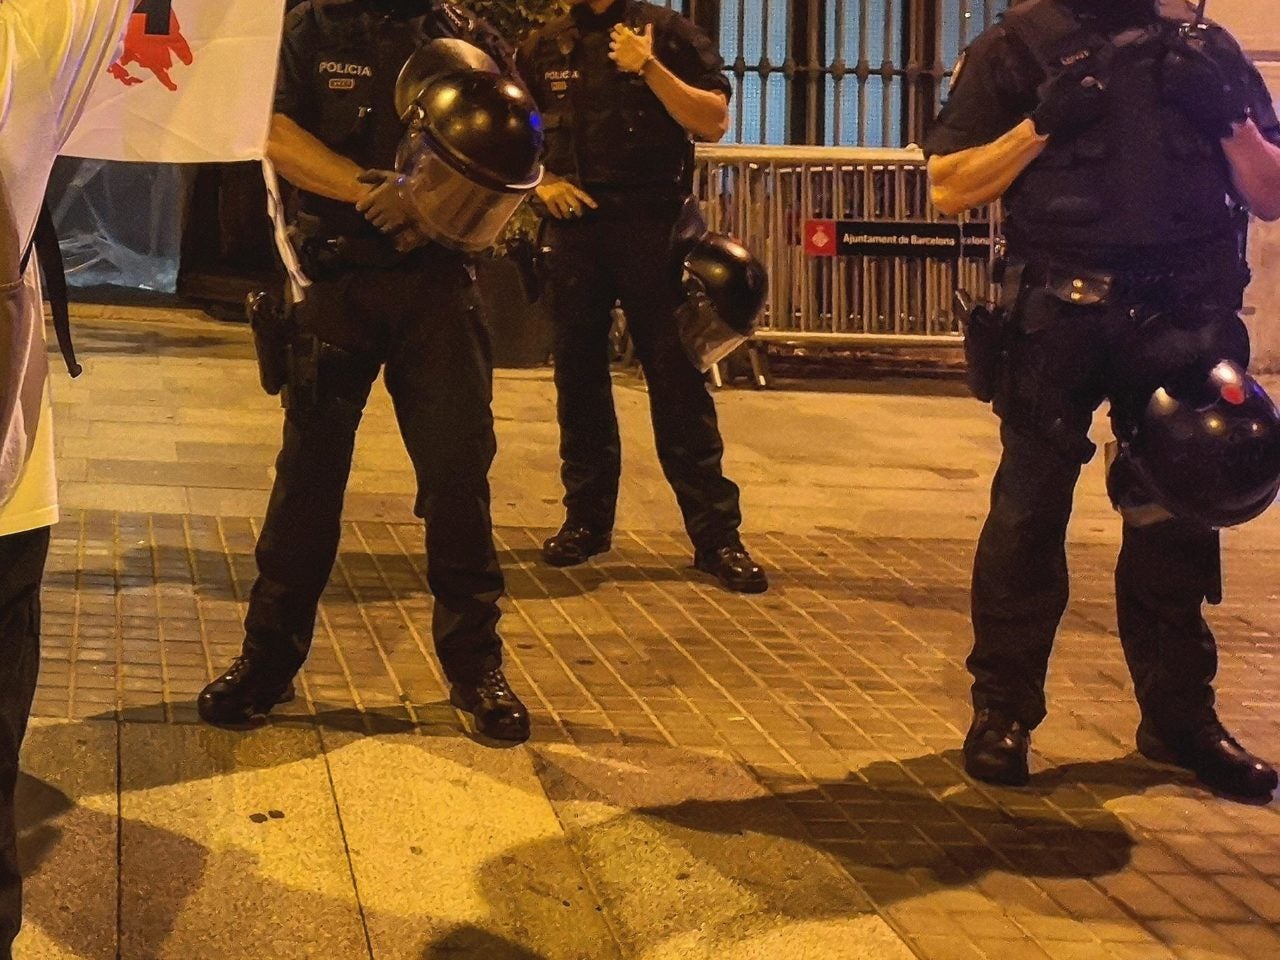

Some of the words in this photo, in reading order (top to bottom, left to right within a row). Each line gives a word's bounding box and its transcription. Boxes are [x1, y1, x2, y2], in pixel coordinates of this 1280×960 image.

[319, 61, 372, 77] POLICIA
[843, 233, 897, 245] Ajuntament
[898, 235, 909, 244] de
[911, 234, 955, 246] Barcelona
